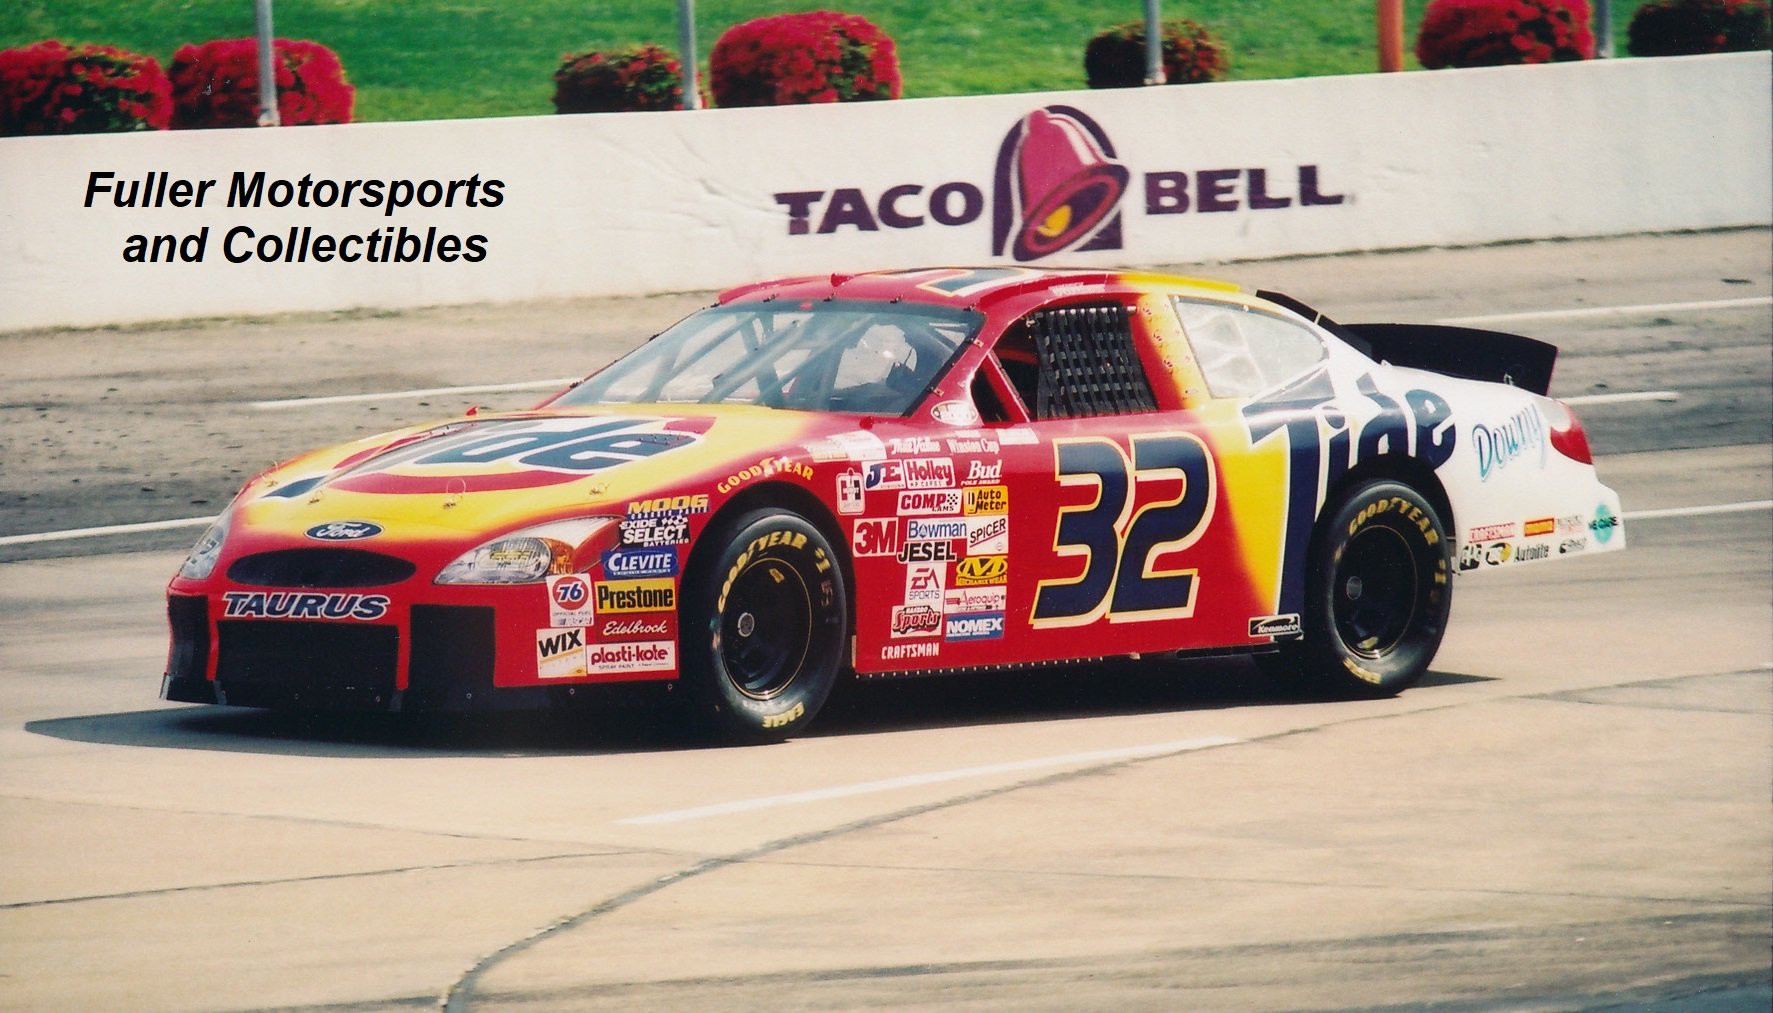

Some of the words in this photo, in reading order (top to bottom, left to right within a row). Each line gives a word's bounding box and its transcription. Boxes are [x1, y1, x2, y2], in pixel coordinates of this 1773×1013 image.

[774, 181, 984, 236] TACO
[1144, 165, 1345, 216] BELL
[1471, 403, 1546, 482] Downy
[717, 456, 814, 494] GOODYEAR
[865, 462, 902, 489] JE
[907, 460, 953, 486] Holley
[966, 459, 1002, 479] Bud
[628, 494, 709, 514] MOOG
[900, 493, 947, 511] COMP
[976, 489, 1001, 501] Auto
[976, 499, 1007, 512] Meter
[1241, 368, 1457, 630] Tide
[316, 522, 370, 538] Ford
[619, 518, 658, 530] EXIDE
[908, 520, 967, 539] Bowman
[969, 518, 1007, 544] SPICER
[1028, 431, 1218, 629] 32
[1349, 497, 1440, 546] GOODYEAR
[622, 524, 688, 545] SELECT
[643, 538, 690, 548] BATTERIES
[855, 520, 897, 554] 3M
[897, 541, 956, 562] JESEL
[608, 553, 673, 572] CLEVITE
[717, 530, 809, 614] GOODYEAR
[910, 567, 940, 590] EA
[558, 582, 584, 602] 76
[597, 585, 674, 609] Prestone
[908, 590, 940, 600] SPORTS
[224, 592, 391, 620] TAURUS
[603, 619, 668, 636] Edelbrock
[892, 609, 941, 635] Sports
[946, 617, 1004, 635] NOMEX
[1257, 623, 1299, 634] Kenmore
[538, 629, 582, 658] WIX
[881, 642, 940, 660] CRAFTSMAN
[591, 644, 669, 665] plasti-kote
[762, 702, 805, 728] EAGLE
